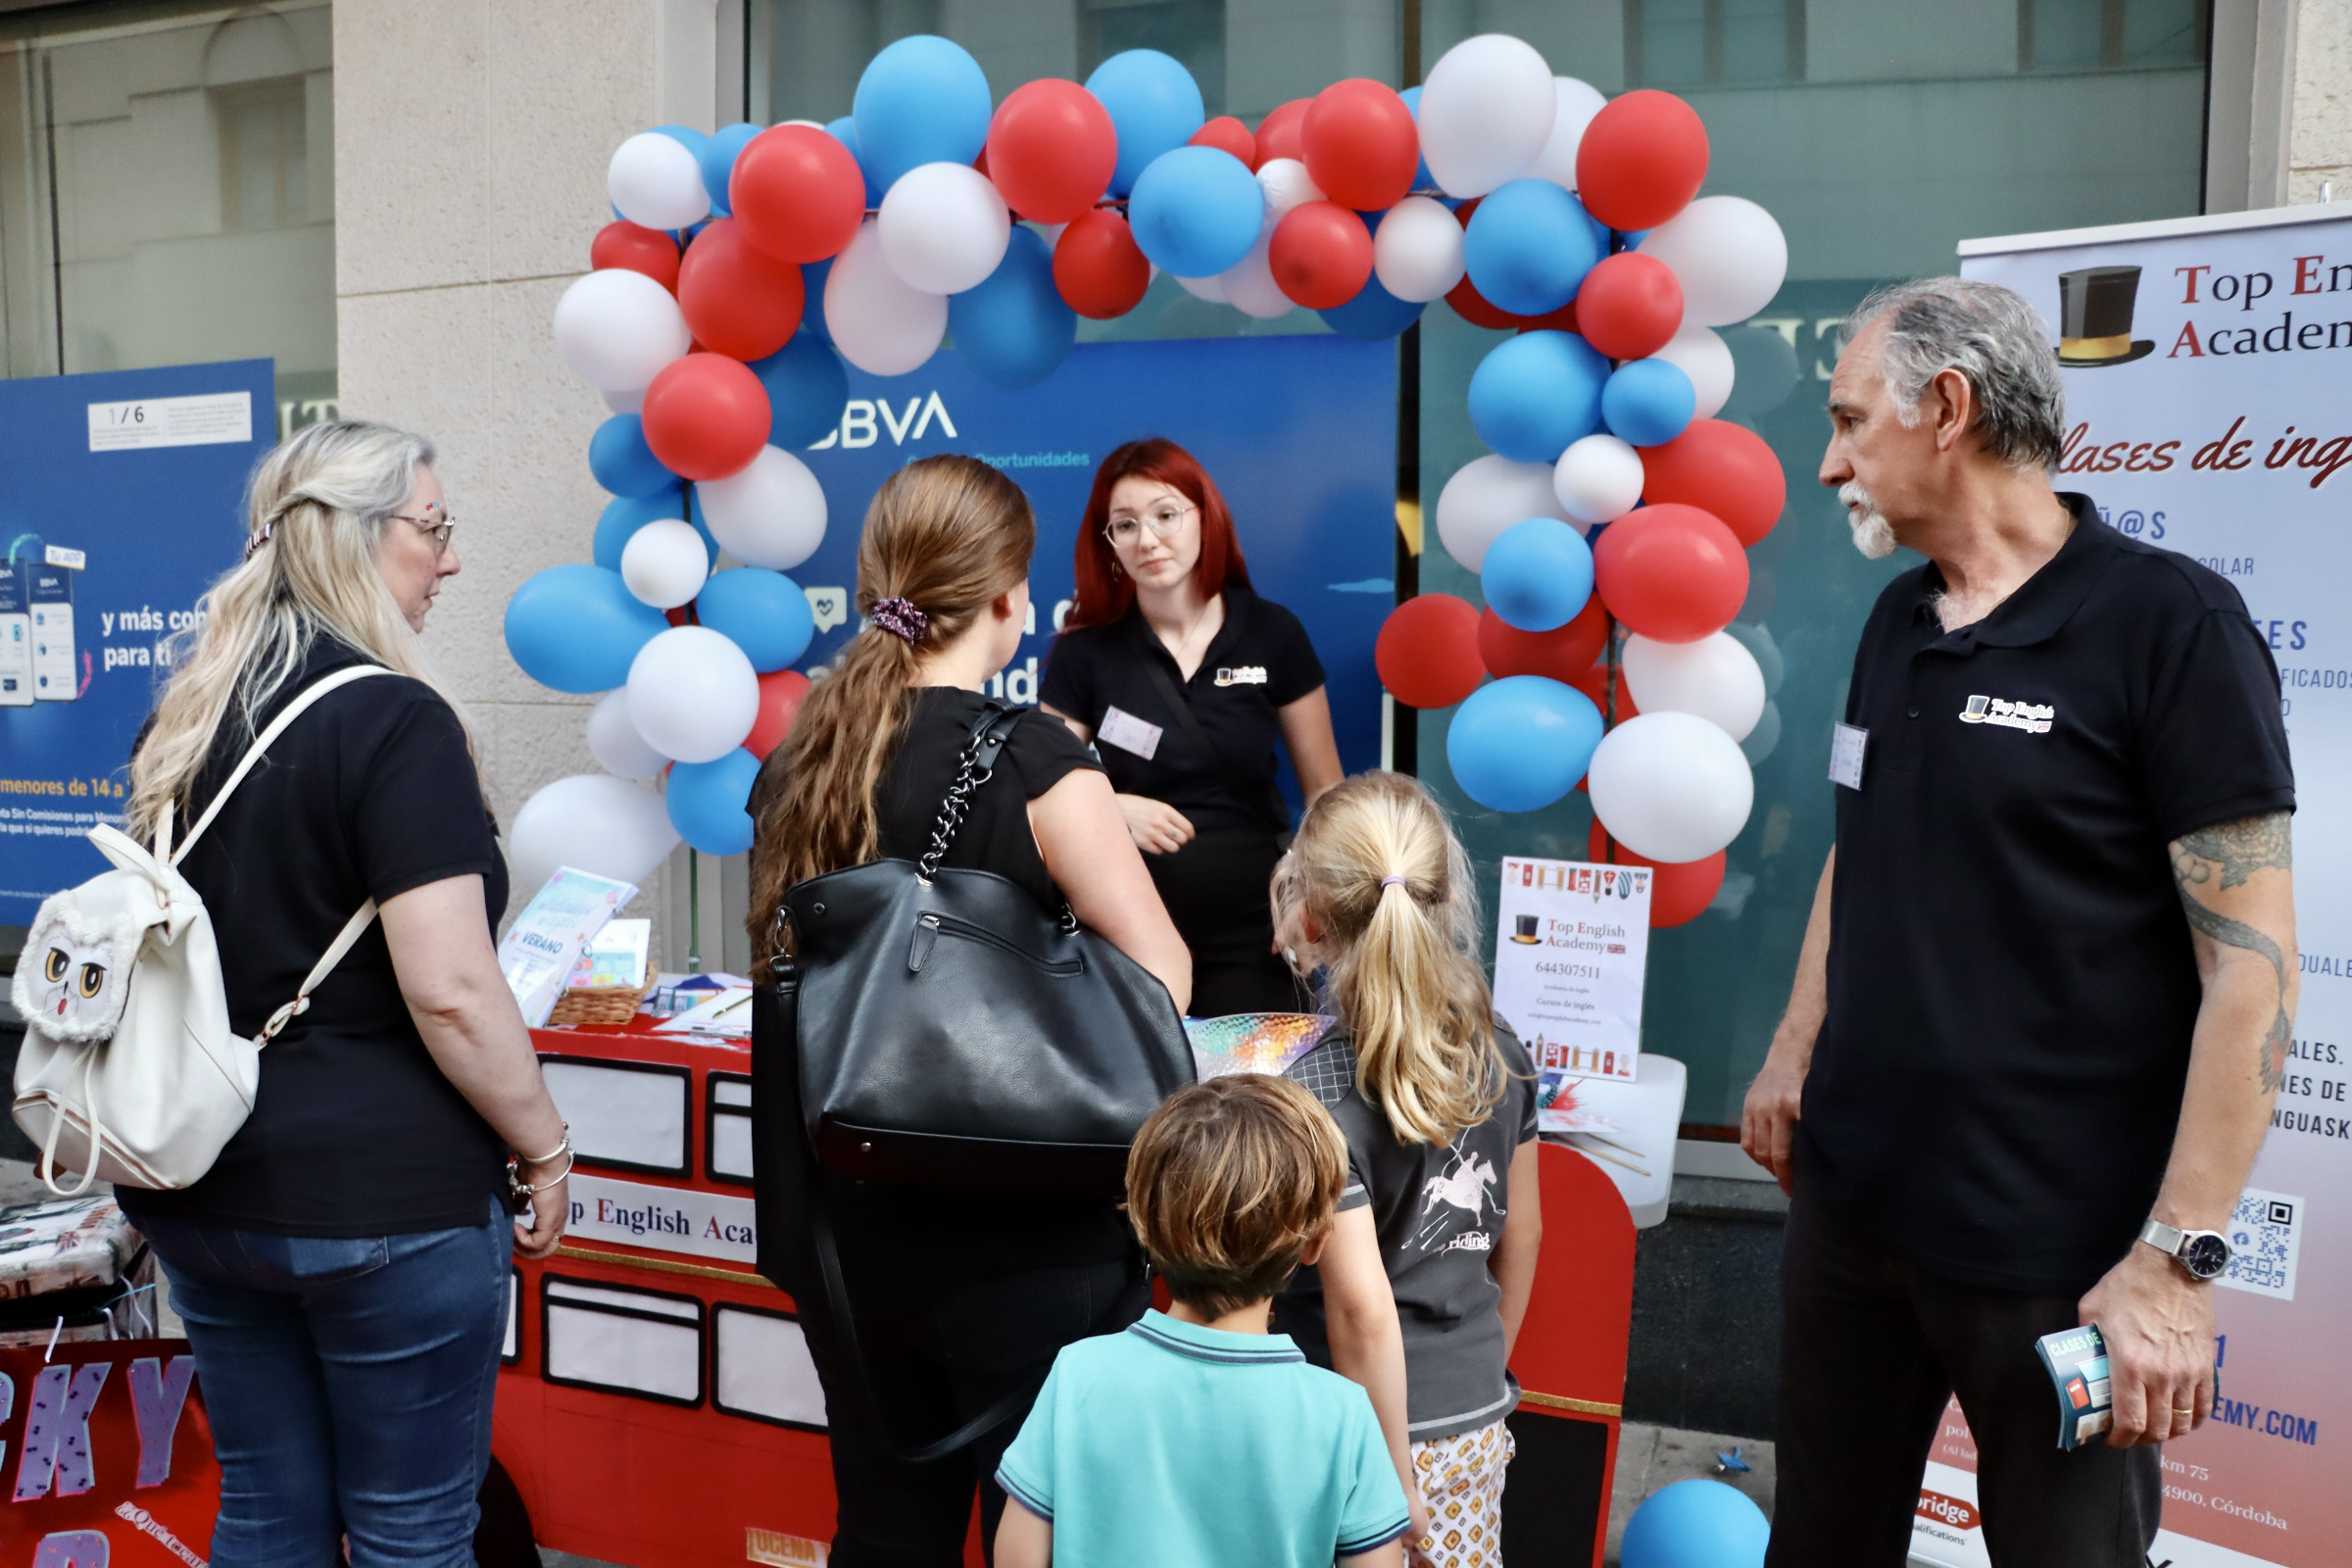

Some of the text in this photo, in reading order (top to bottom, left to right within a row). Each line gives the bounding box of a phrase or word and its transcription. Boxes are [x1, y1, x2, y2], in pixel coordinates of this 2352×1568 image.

[2174, 265, 2274, 312] Top
[808, 390, 958, 450] BVA
[2059, 422, 2181, 474] lases
[2191, 416, 2254, 470] de
[50, 550, 81, 564] Tu app
[101, 612, 115, 637] y
[120, 605, 164, 631] más
[2252, 619, 2307, 651] ES
[104, 642, 172, 672] para ti
[2280, 668, 2352, 689] FICADO
[1991, 699, 2054, 719] Top English
[1985, 711, 2036, 733] Academy
[0, 780, 65, 795] menores
[69, 778, 87, 796] de
[91, 778, 110, 797] 14
[113, 784, 123, 798] a
[1547, 918, 1626, 938] Top English
[521, 931, 564, 955] VERANO
[1545, 935, 1606, 955] Academy
[1535, 961, 1600, 979] 644307511
[1536, 997, 1561, 1007] Cursos
[1573, 1001, 1595, 1012] inglés
[2321, 1080, 2347, 1102] DE
[596, 1198, 691, 1236] English
[704, 1215, 757, 1245] Aca
[1448, 1231, 1491, 1250] riding
[2049, 1332, 2102, 1356] CLASES DE
[0, 1355, 196, 1502] KY
[2159, 1454, 2209, 1482] km 75
[2211, 1496, 2288, 1531] Córdoba
